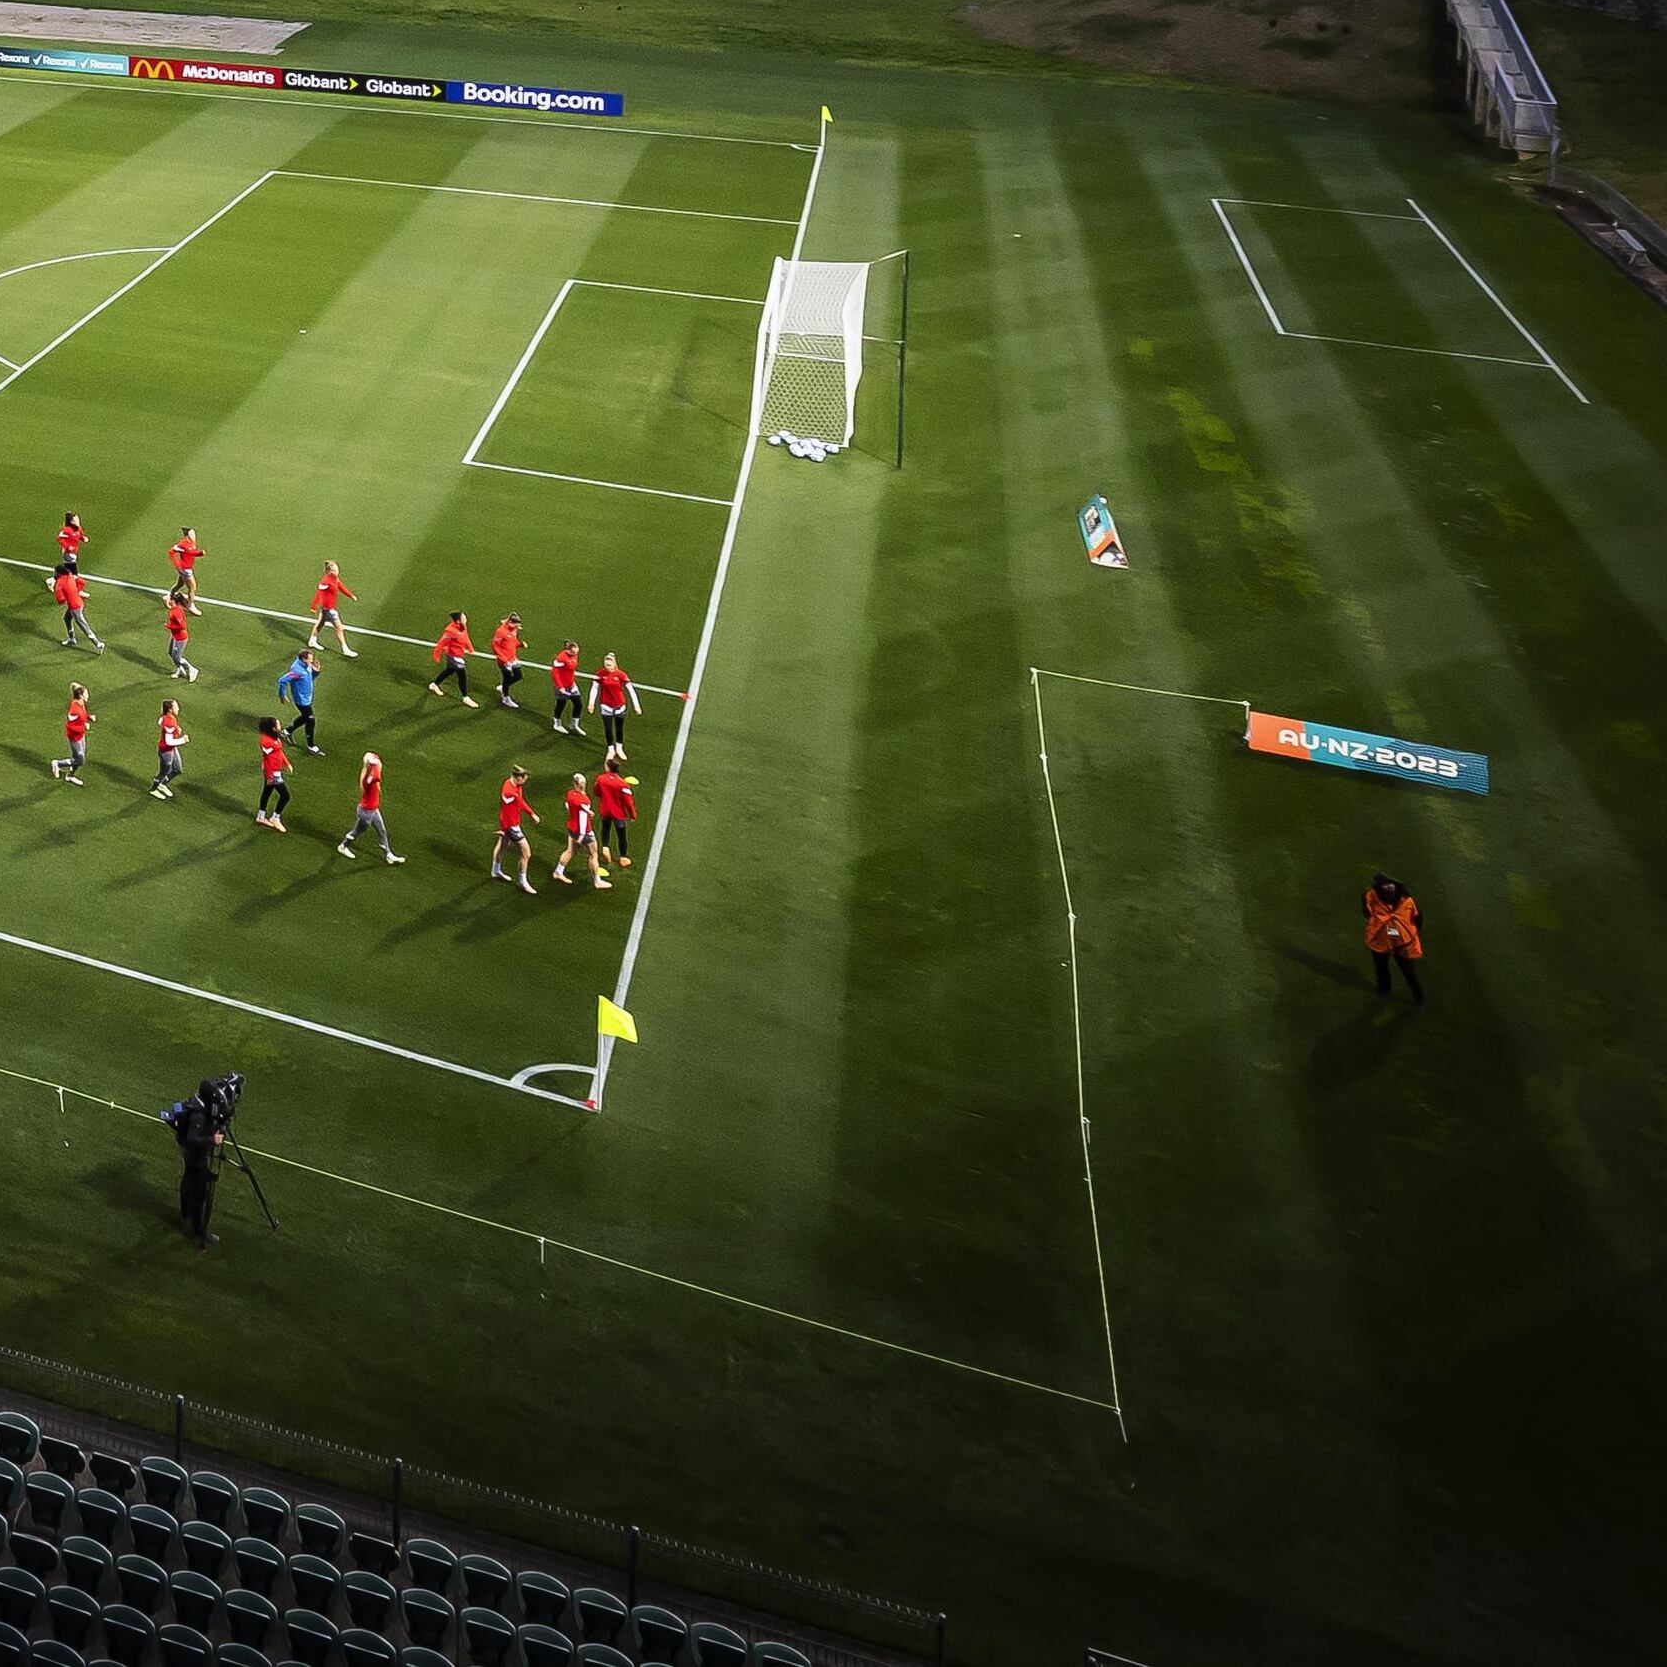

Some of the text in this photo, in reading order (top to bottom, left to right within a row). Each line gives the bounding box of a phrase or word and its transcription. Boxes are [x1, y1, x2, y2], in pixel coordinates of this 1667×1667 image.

[43, 54, 76, 67] Rexona
[182, 64, 275, 85] McDonald's
[285, 72, 431, 97] Globant Globant
[463, 82, 605, 112] Booking.com
